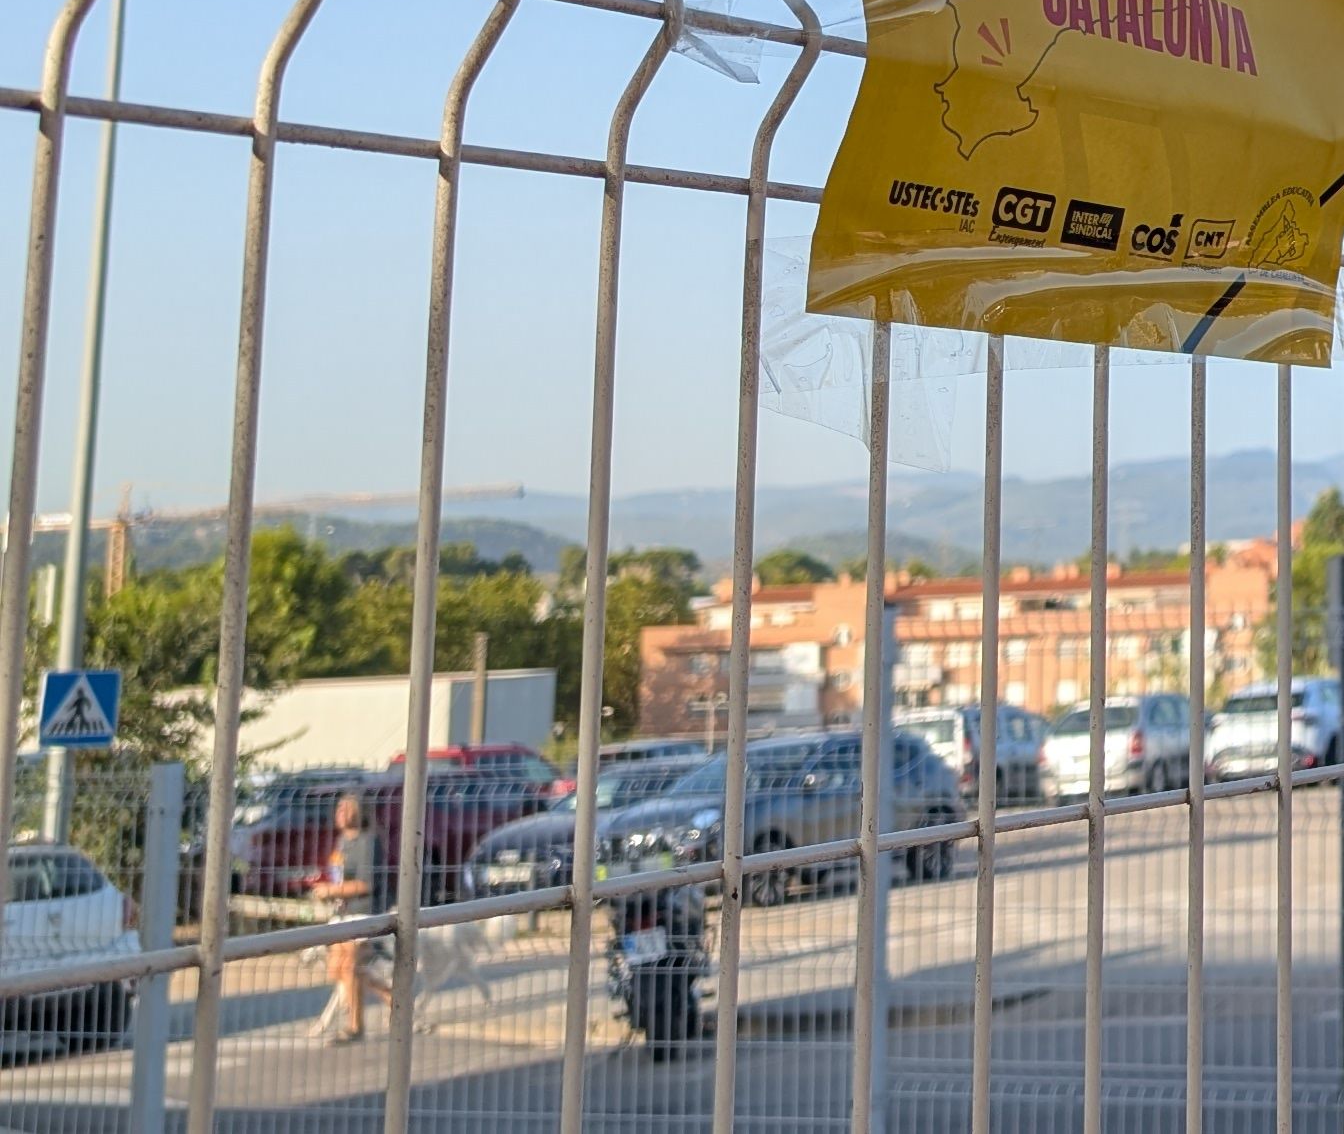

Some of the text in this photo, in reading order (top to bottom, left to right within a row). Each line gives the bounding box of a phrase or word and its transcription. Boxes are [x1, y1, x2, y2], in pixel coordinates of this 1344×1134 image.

[998, 194, 1052, 226] CGT
[959, 219, 976, 234] IAC
[1070, 224, 1113, 241] SINDICAL
[1194, 230, 1225, 248] CNT
